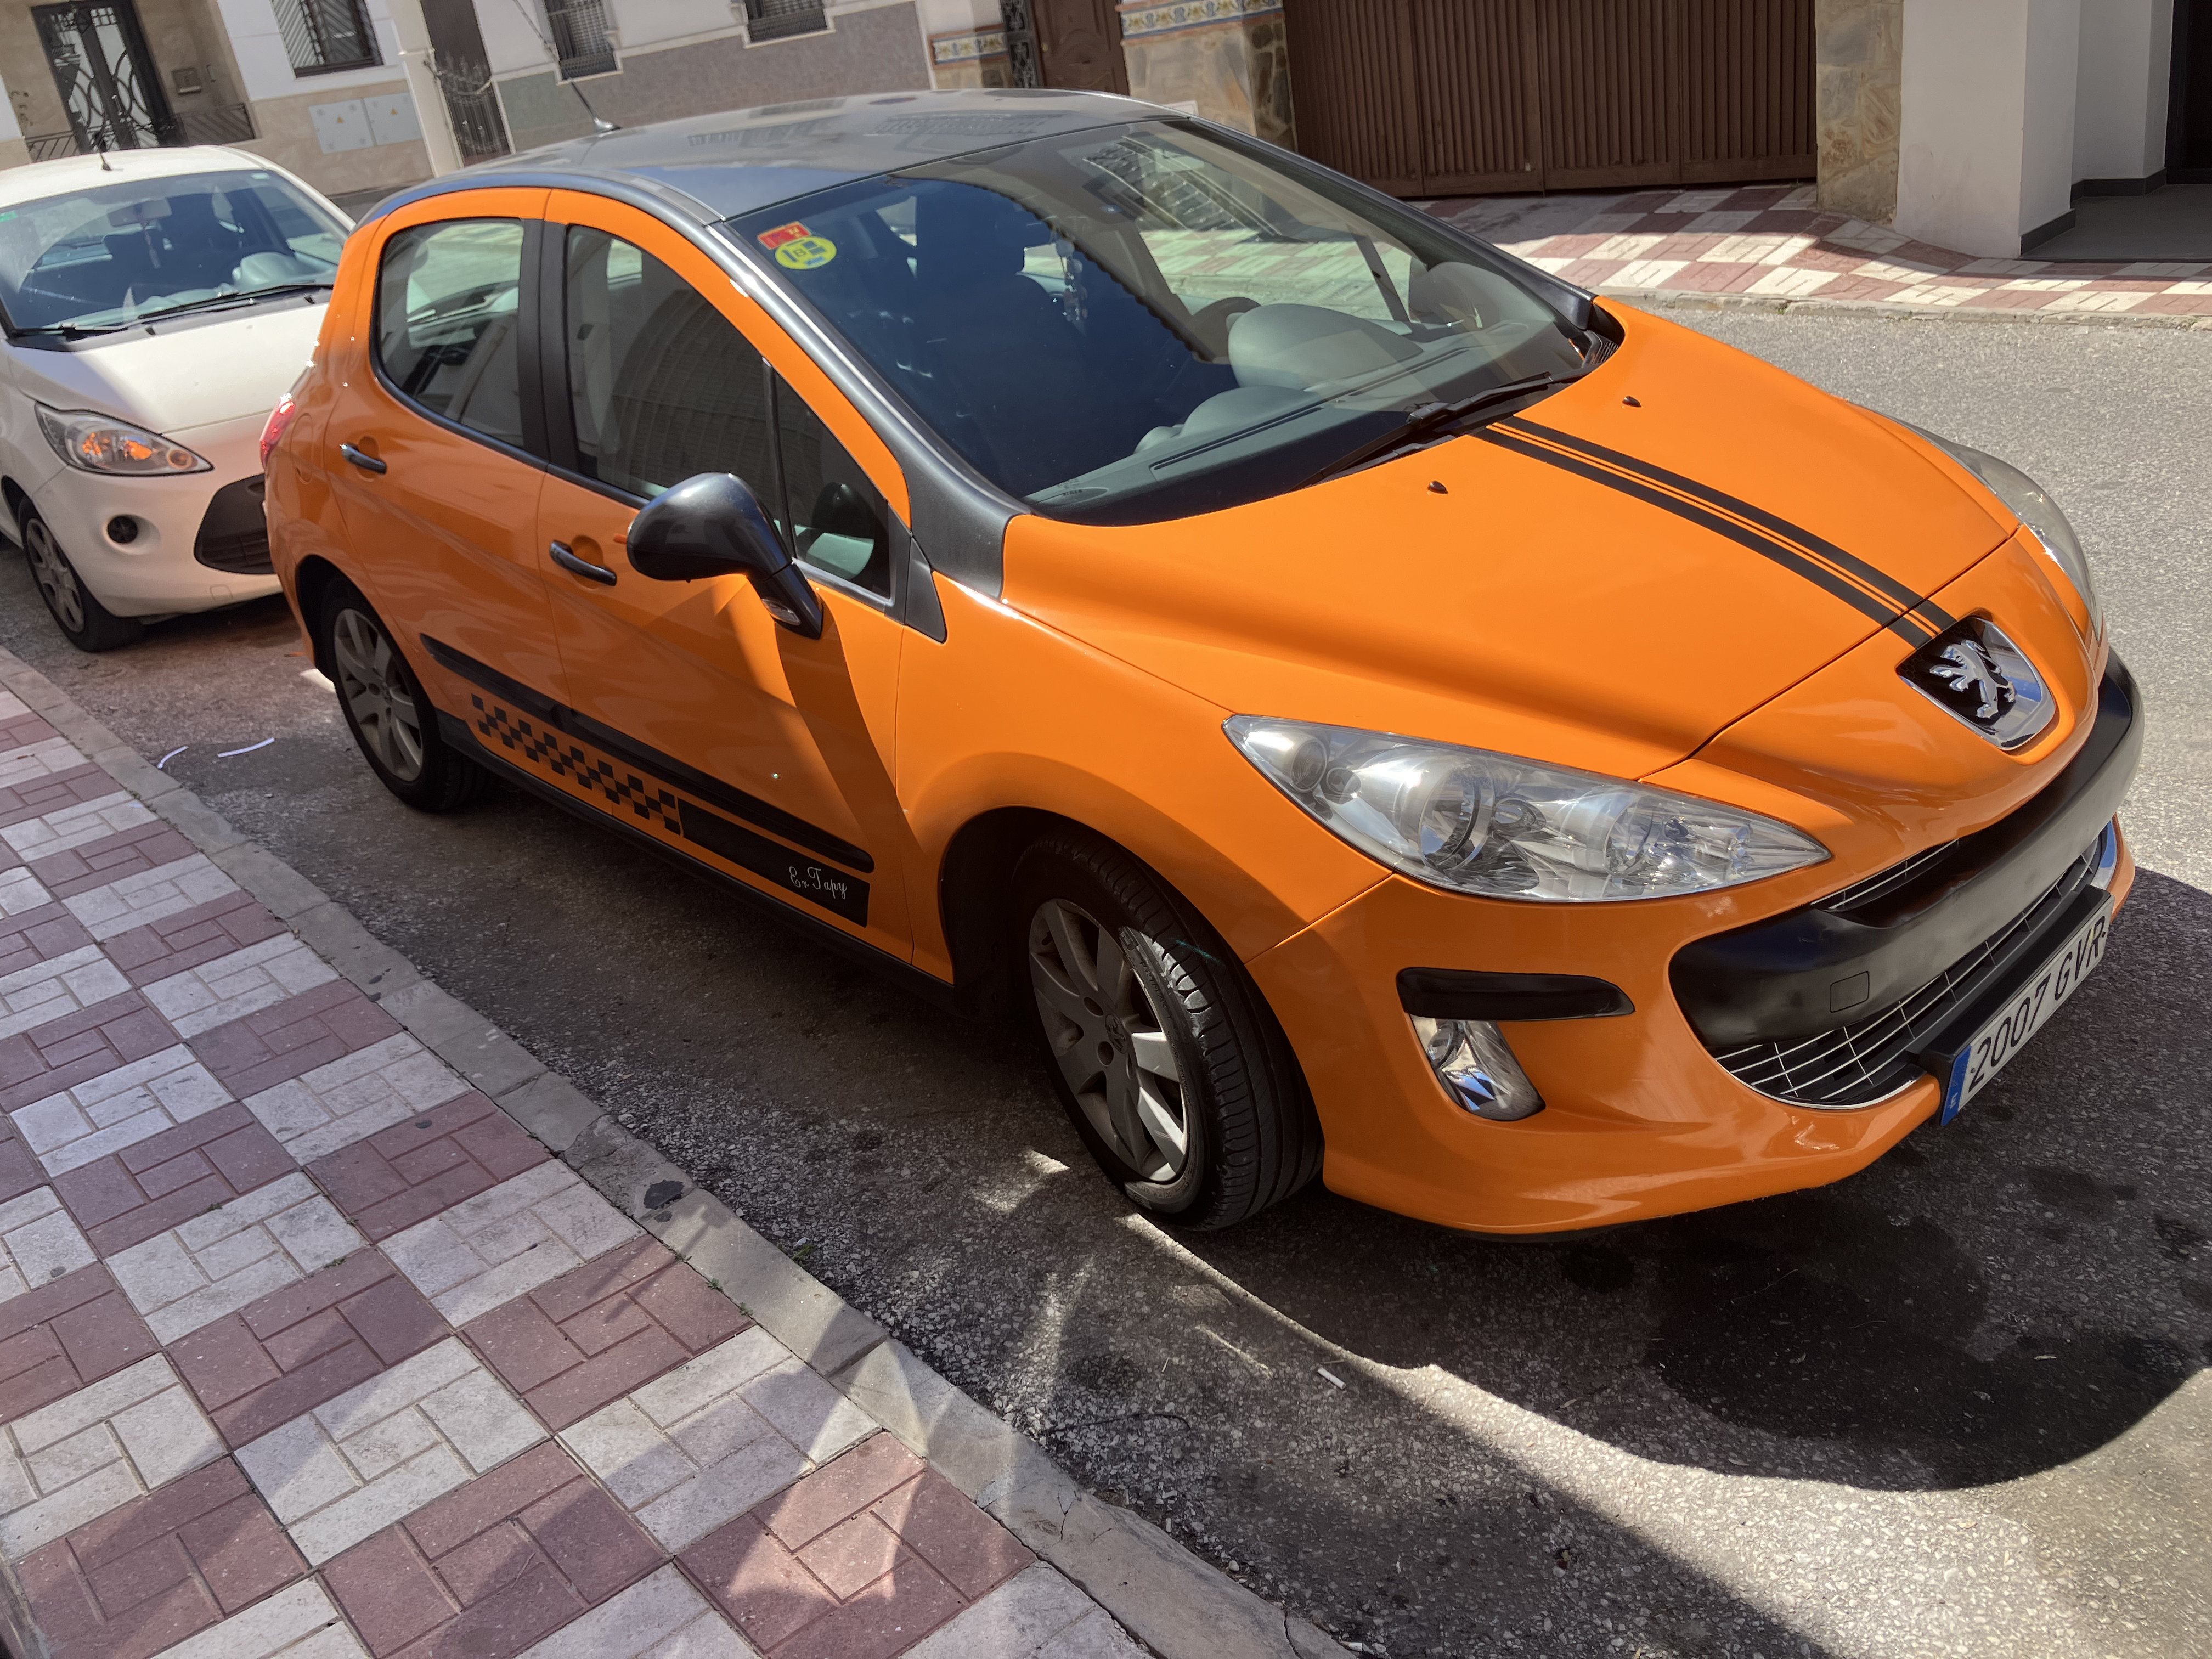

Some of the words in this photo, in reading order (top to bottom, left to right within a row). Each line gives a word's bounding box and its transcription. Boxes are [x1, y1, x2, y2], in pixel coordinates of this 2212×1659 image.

[807, 867, 847, 899] Tapy
[1968, 973, 2051, 1094] 2007
[2054, 915, 2106, 1001] GVR
